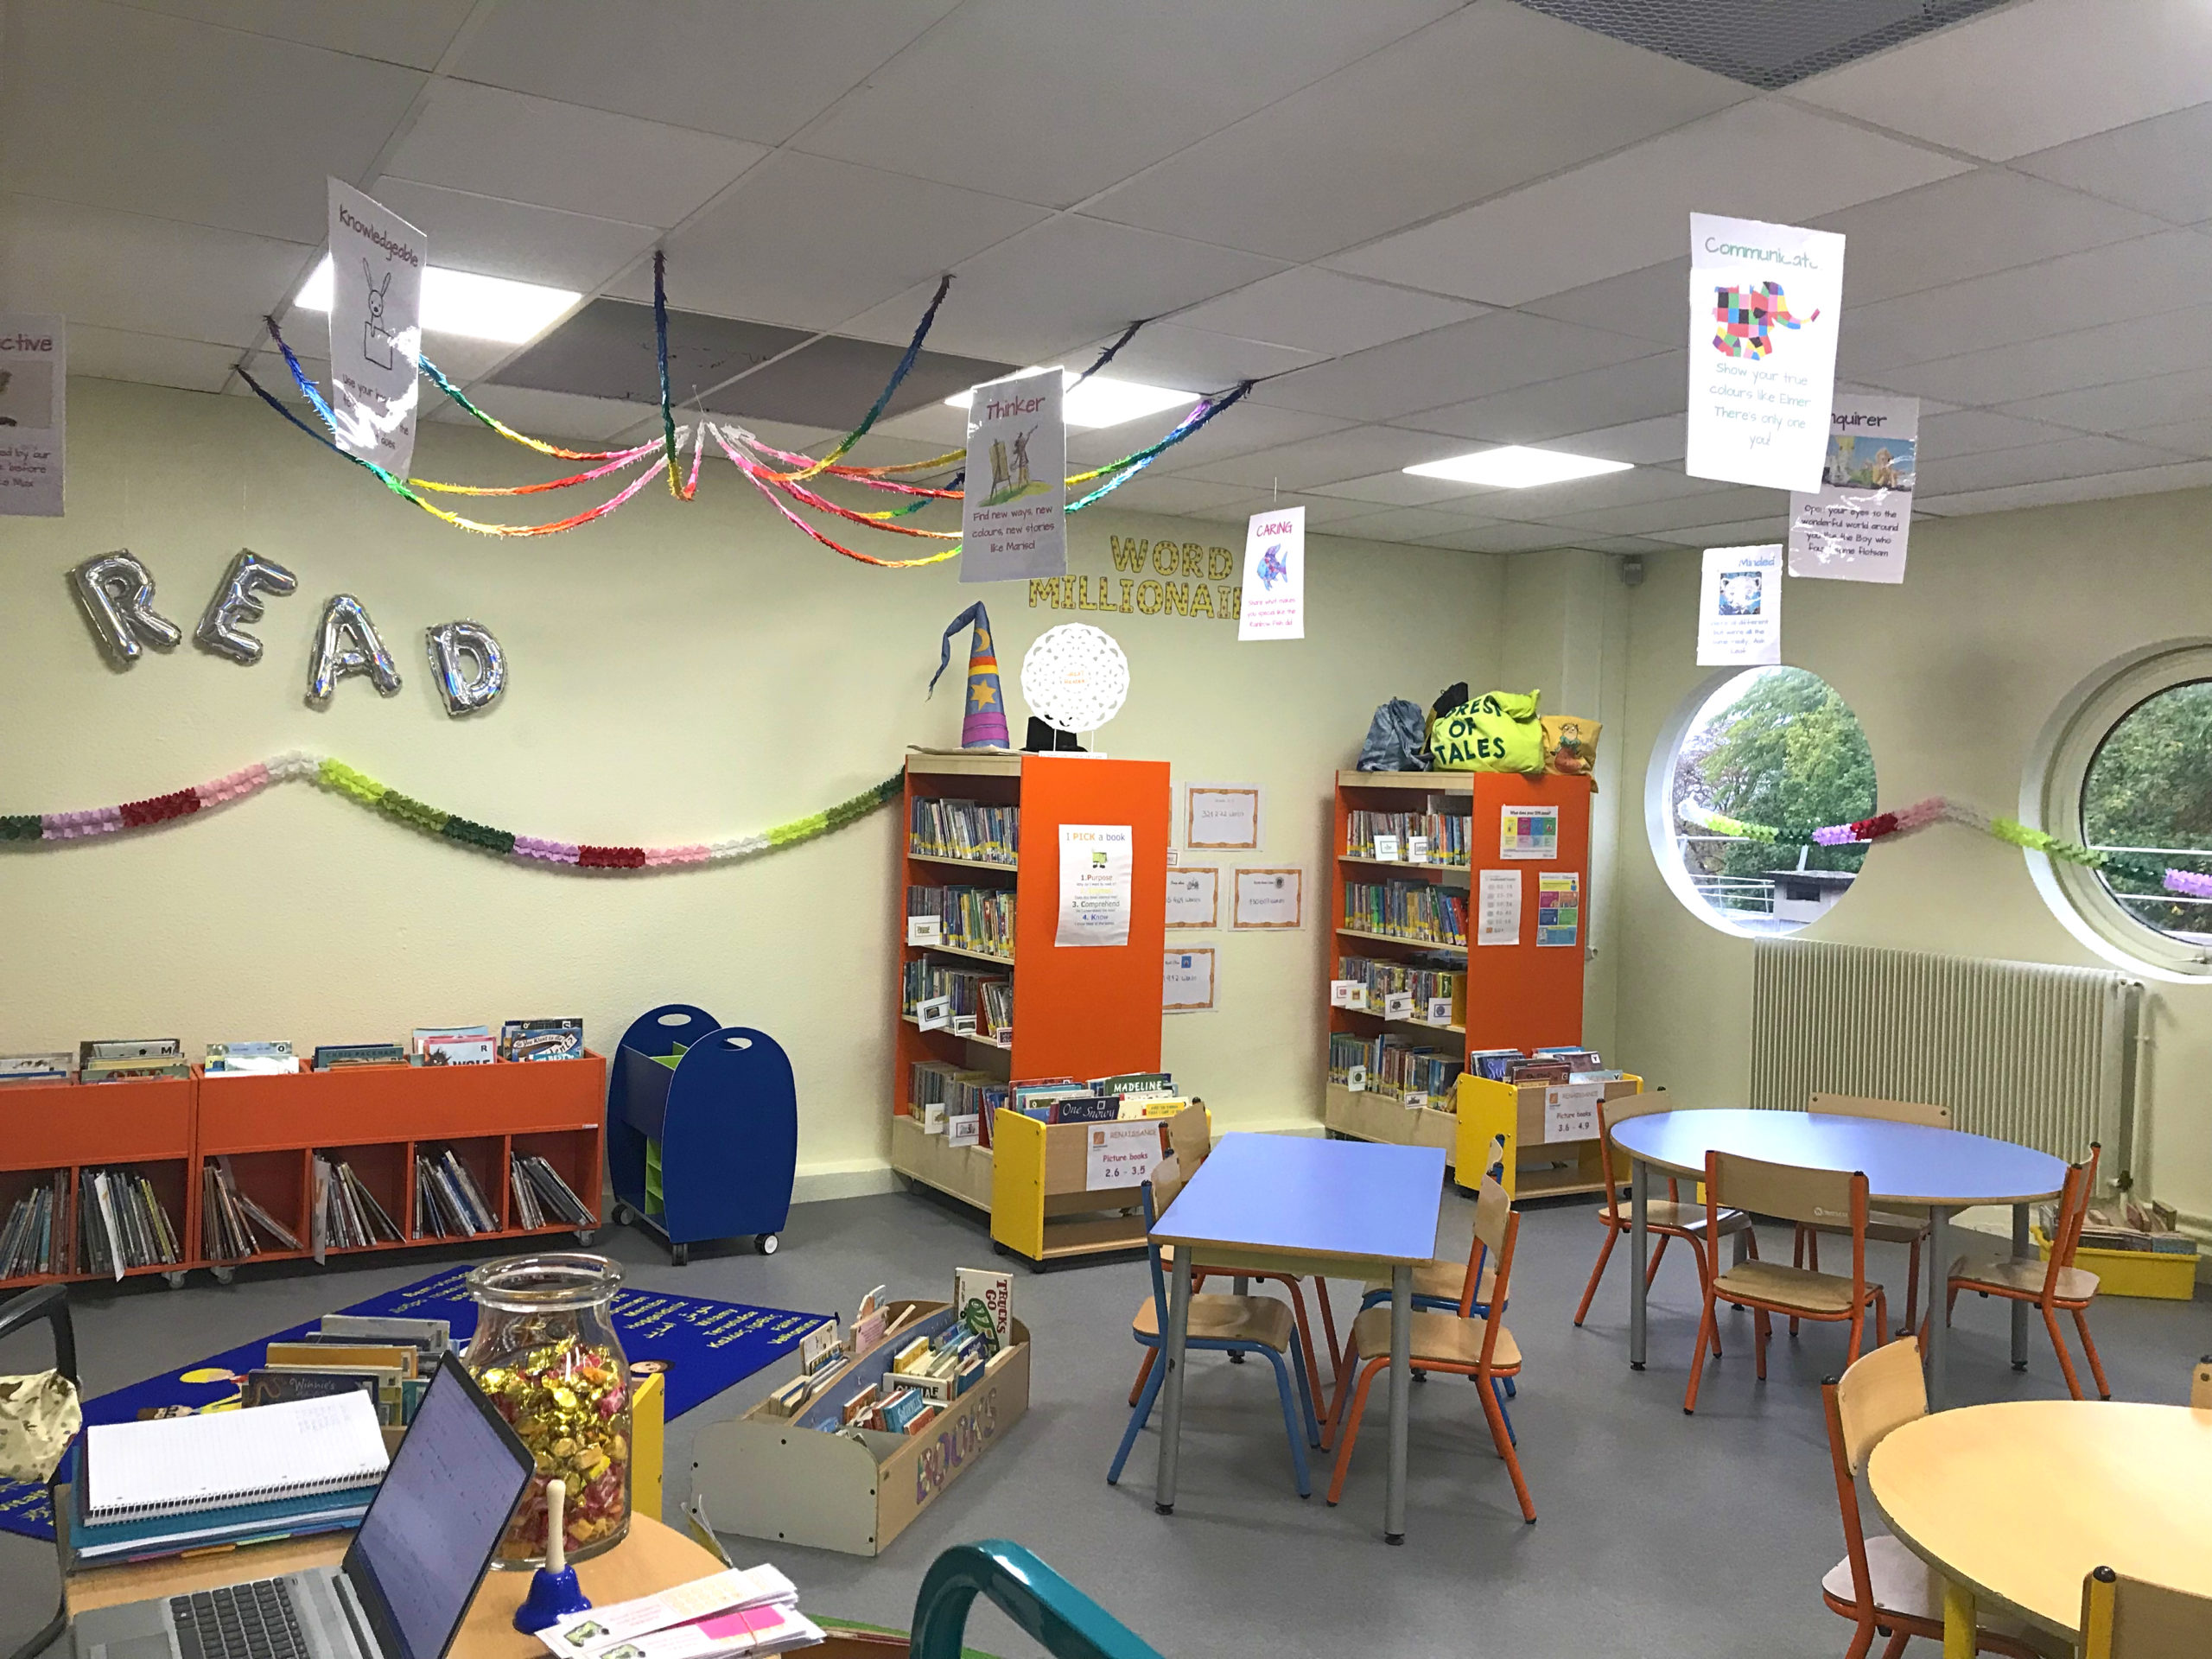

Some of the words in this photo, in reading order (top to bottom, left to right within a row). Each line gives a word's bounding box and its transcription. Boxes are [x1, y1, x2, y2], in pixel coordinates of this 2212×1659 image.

[340, 204, 419, 267] Knowledgeable
[1705, 237, 1818, 269] Communicat
[0, 334, 53, 352] ctive
[1715, 362, 1747, 375] Show
[1752, 370, 1779, 385] your
[1783, 372, 1808, 386] true
[357, 384, 374, 398] your
[1709, 385, 1753, 398] colours
[1757, 389, 1775, 403] like
[1779, 393, 1812, 408] Elmer
[987, 395, 1046, 421] Thinker
[1714, 406, 1757, 422] There's
[1761, 412, 1783, 430] only
[1787, 417, 1807, 429] one
[1831, 411, 1888, 431] nquirer
[973, 509, 989, 522] Find
[991, 510, 1008, 519] new
[1035, 505, 1053, 516] new
[1827, 507, 1847, 518] your
[1850, 509, 1870, 519] eyes
[1885, 510, 1897, 518] the
[972, 525, 1004, 538] colours,
[1006, 524, 1023, 536] new
[1026, 521, 1055, 533] stories
[1256, 521, 1294, 537] CARING
[1801, 518, 1843, 528] wonderful
[1871, 522, 1899, 531] around
[990, 543, 1004, 553] like
[1006, 540, 1036, 551] Marisol
[1855, 533, 1872, 546] Boy
[1875, 536, 1891, 544] who
[1110, 535, 1233, 581] WORD
[1738, 556, 1776, 568] Minded
[67, 547, 508, 719] READ
[1433, 737, 1506, 766] TALES
[1073, 832, 1096, 842] PICK
[1106, 832, 1126, 842] book
[1080, 900, 1121, 909] Comprehend
[161, 1046, 173, 1055] M
[1113, 1080, 1163, 1094] MADELINE
[1062, 1103, 1081, 1117] One
[1083, 1105, 1116, 1121] Snowy
[1556, 1111, 1575, 1120] Picture
[1109, 1127, 1157, 1140] RENAISSANCE
[1558, 1122, 1570, 1132] 3.6
[1578, 1122, 1590, 1131] 4.9
[1103, 1153, 1127, 1163] Picture
[1128, 1152, 1148, 1161] books
[1105, 1167, 1120, 1178] 2.6
[1131, 1166, 1146, 1177] 3.5
[985, 1288, 997, 1311] GO
[996, 1279, 1008, 1334] TRUCKS
[289, 1377, 336, 1392] Winnie's
[916, 1387, 997, 1505] BOOKS
